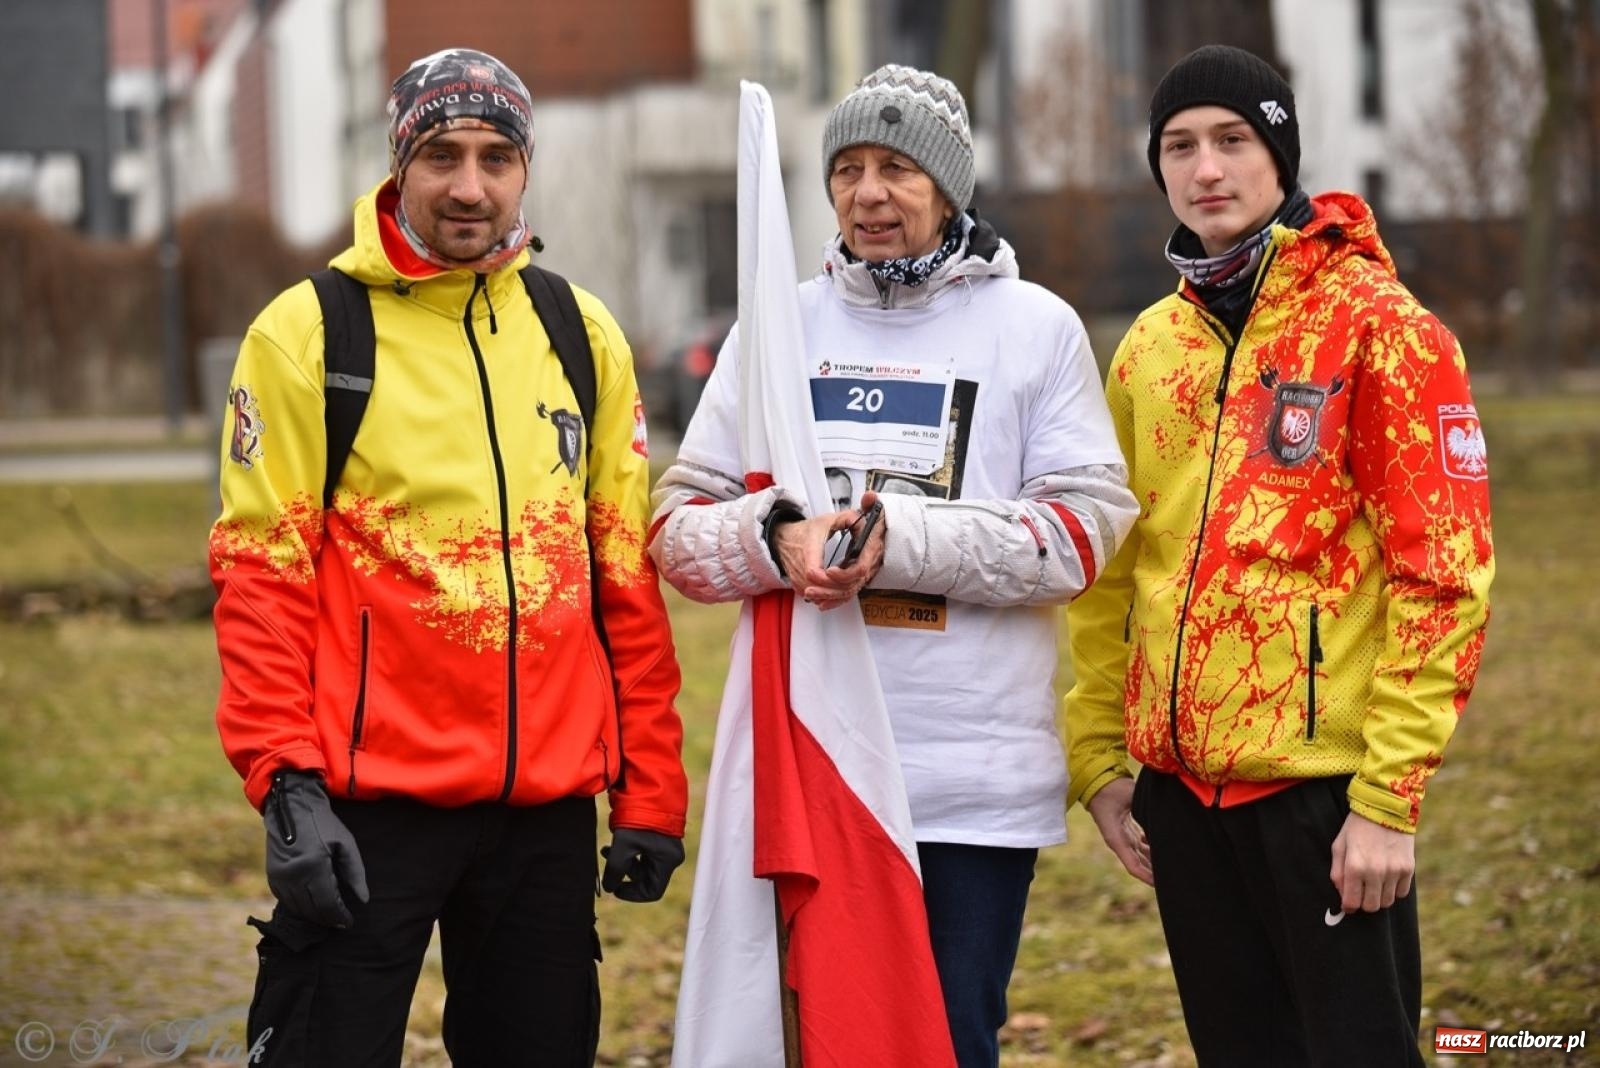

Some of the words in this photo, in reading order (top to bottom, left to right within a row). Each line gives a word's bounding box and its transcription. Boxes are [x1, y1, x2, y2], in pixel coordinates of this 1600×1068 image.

[469, 92, 485, 104] o
[1259, 100, 1289, 126] 4F
[834, 364, 874, 374] TROPEM
[846, 386, 885, 413] 20
[902, 429, 921, 437] godz.
[922, 430, 940, 440] 11.00
[1258, 471, 1311, 490] ADAMEX
[864, 603, 906, 620] EDYCJA
[908, 606, 939, 624] 2025
